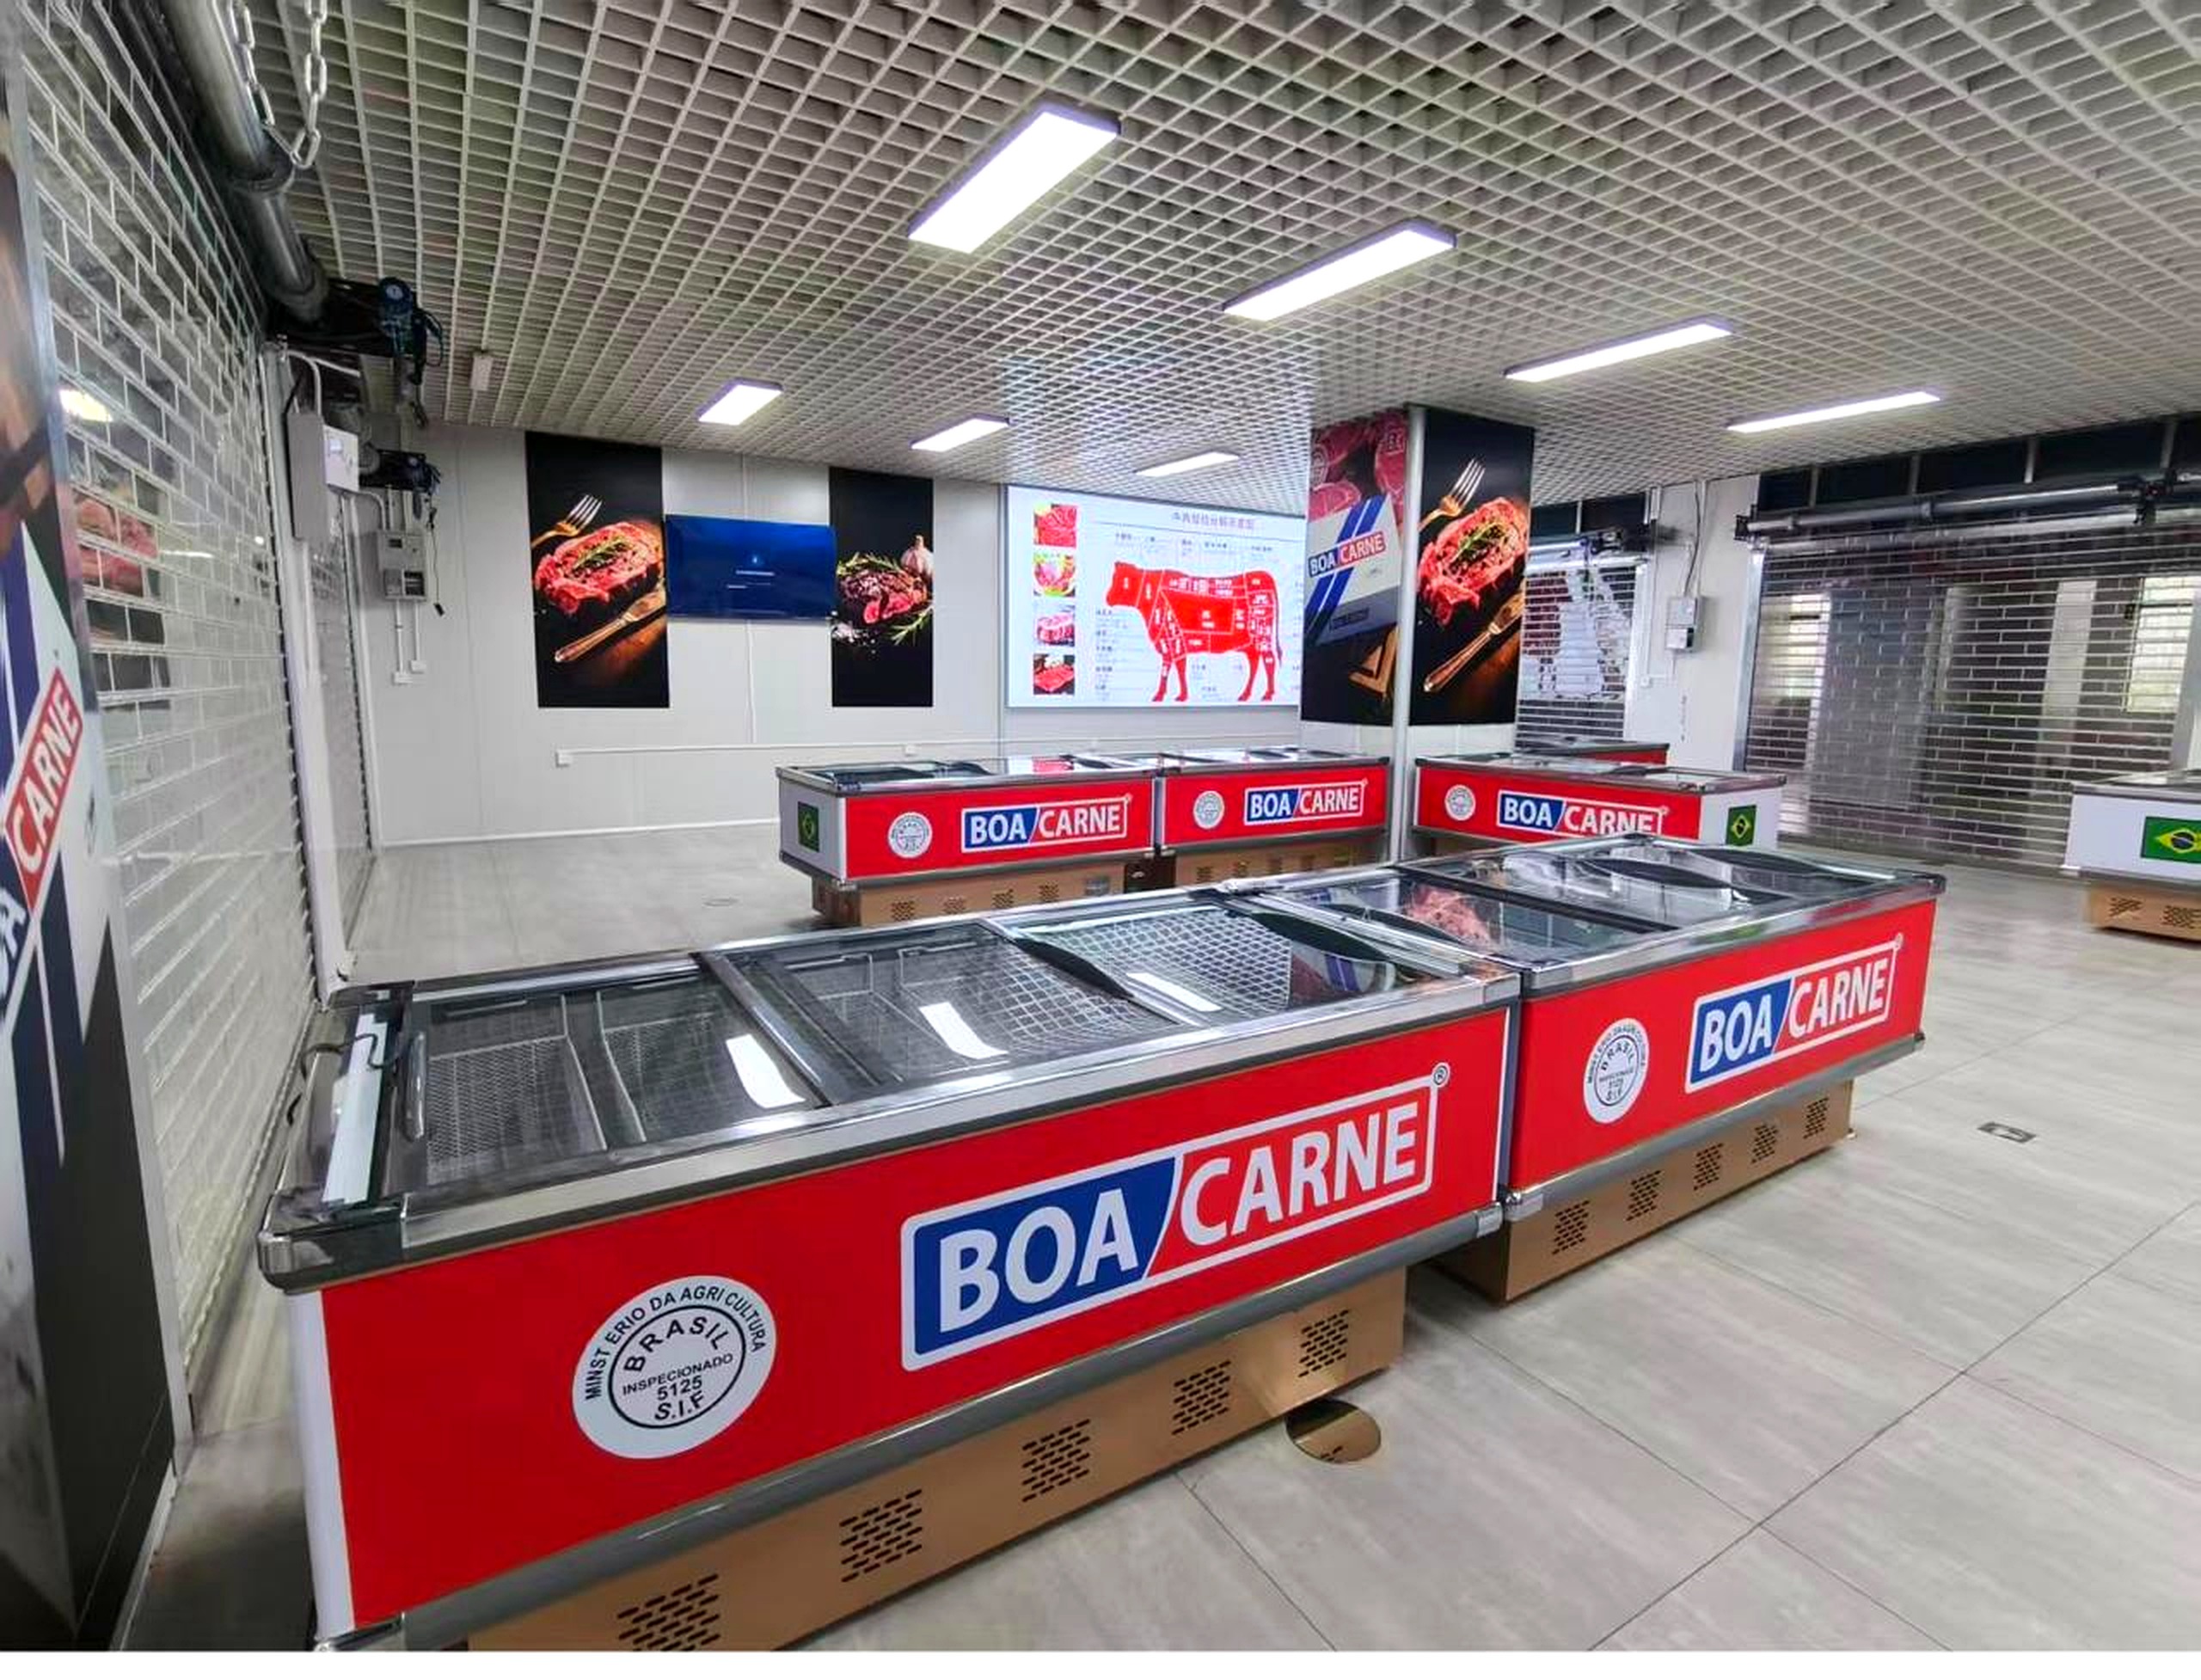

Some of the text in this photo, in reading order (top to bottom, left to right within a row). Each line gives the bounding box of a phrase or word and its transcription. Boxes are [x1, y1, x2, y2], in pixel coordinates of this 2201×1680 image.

[1309, 534, 1384, 576] BOA CARNE
[13, 679, 79, 874] CARNE
[970, 805, 1121, 844] BOA CARNE
[1249, 792, 1291, 819] BOA
[1298, 788, 1359, 814] CARNE
[1503, 797, 1553, 827] BOA
[1563, 805, 1653, 834] CARNE
[1700, 994, 1772, 1072] BOA
[1788, 958, 1888, 1039] CARNE
[939, 1102, 1416, 1333] BOA CARNE
[649, 1291, 677, 1312] DA
[623, 1316, 730, 1373] BRASIL
[622, 1352, 734, 1396] INSPECIONADO
[656, 1375, 703, 1401] 5125
